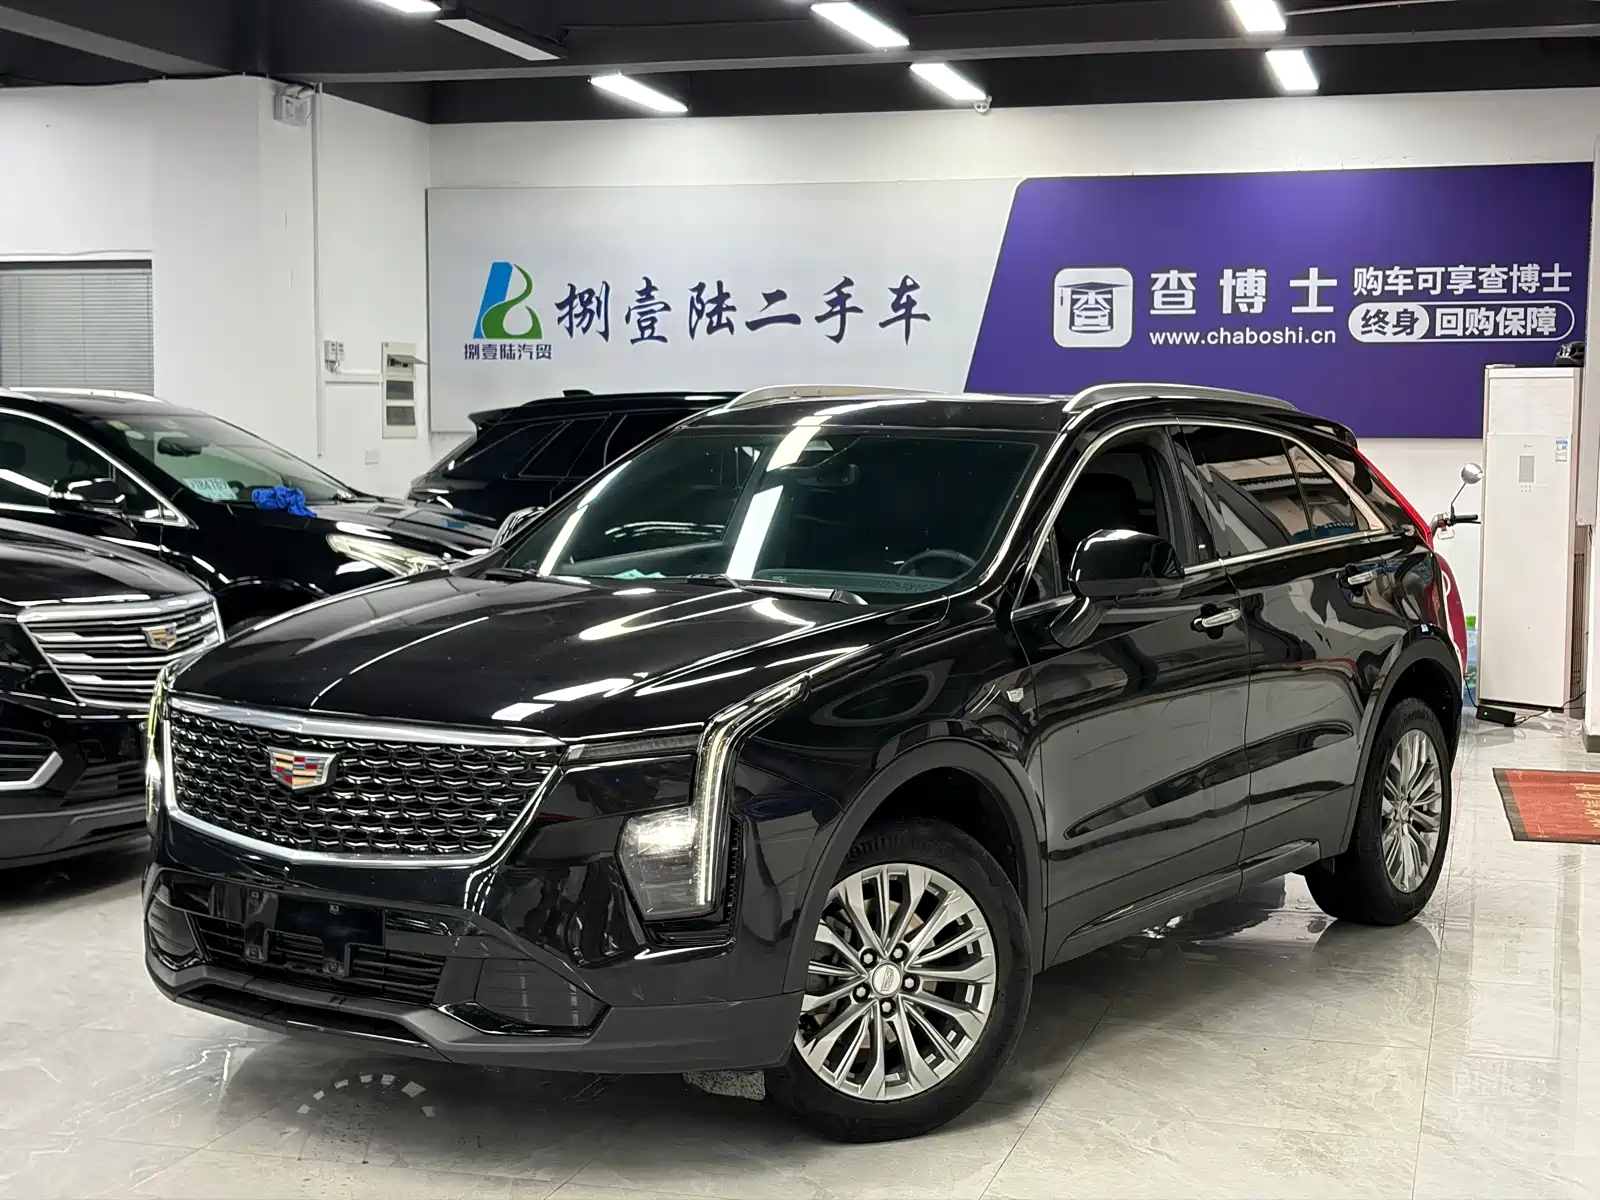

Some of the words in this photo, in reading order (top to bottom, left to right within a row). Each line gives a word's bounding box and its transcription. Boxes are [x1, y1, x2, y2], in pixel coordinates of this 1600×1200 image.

[1150, 267, 1337, 314] 查博士
[1353, 263, 1572, 296] 购车可享查博士
[555, 275, 931, 345] 捌壹陆二手车
[1361, 308, 1419, 336] 终身
[1435, 306, 1557, 336] 回购保障
[1150, 327, 1336, 346] www.chaboshi.cn
[464, 344, 552, 360] 捌壹陆汽贸
